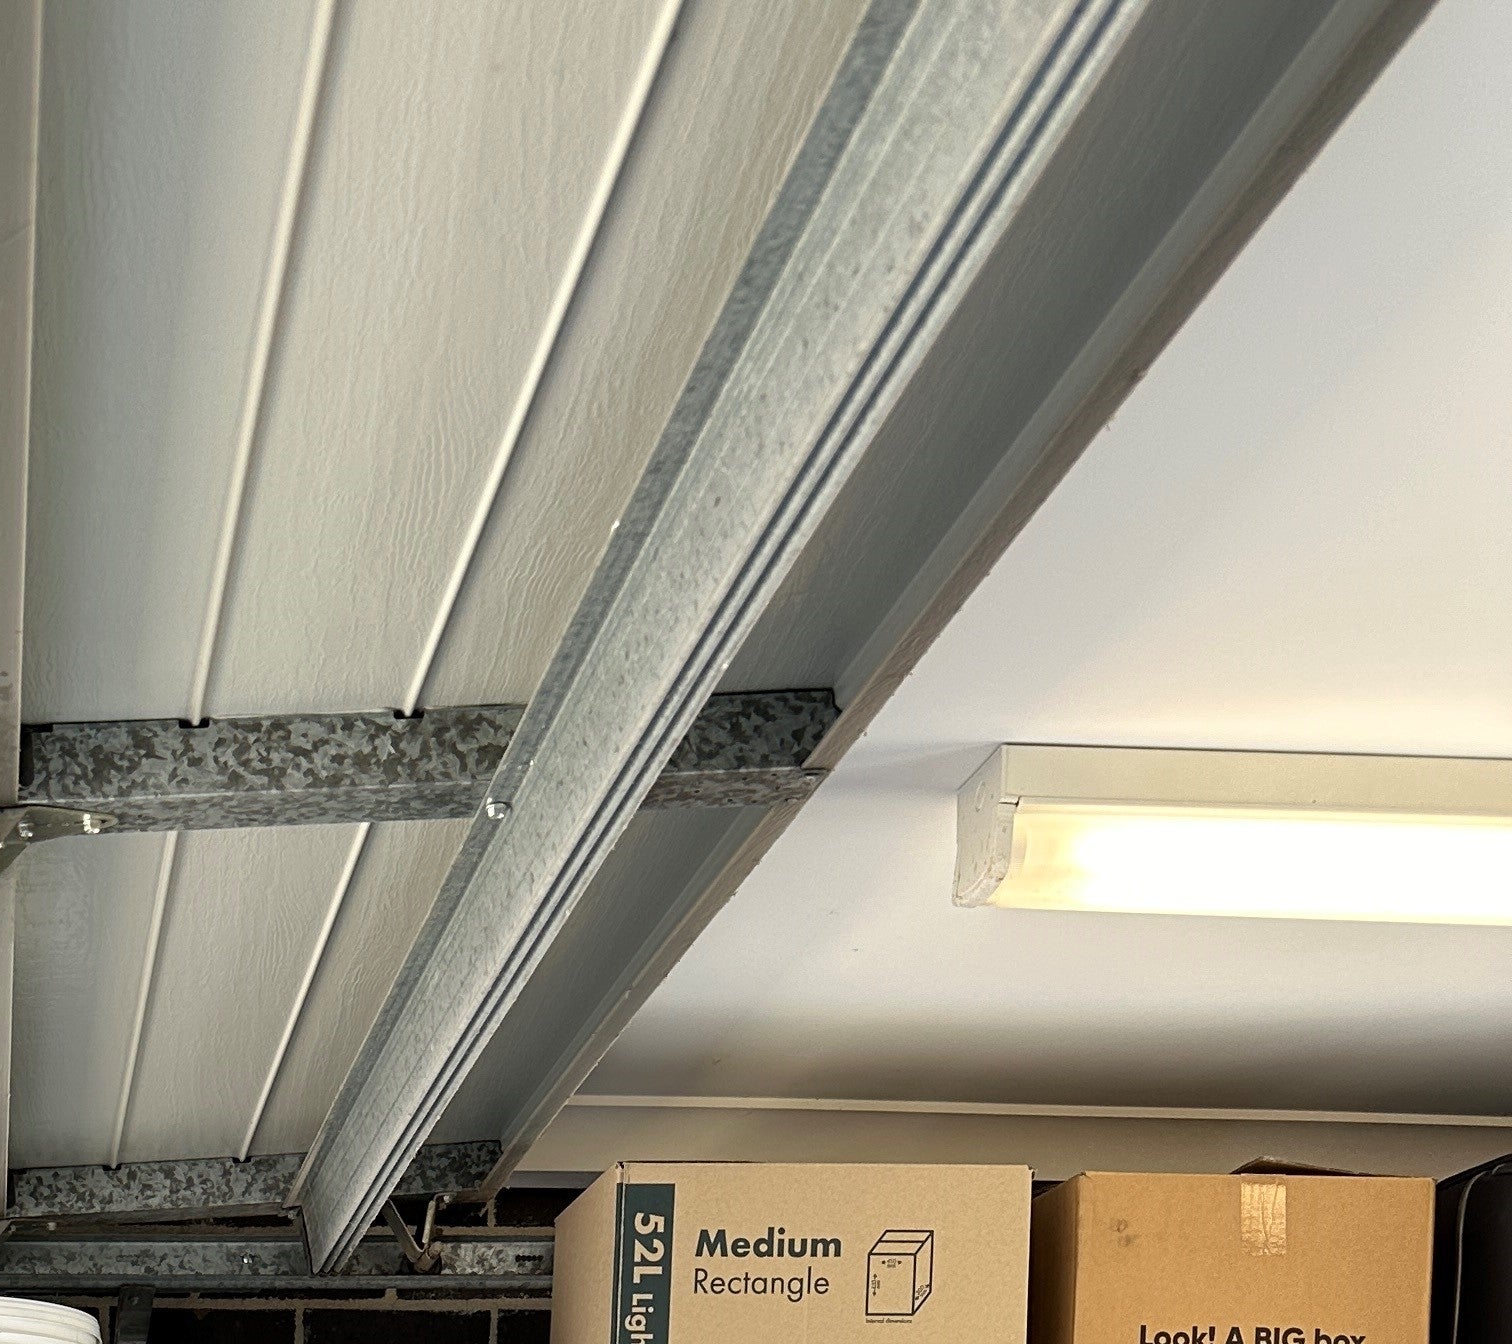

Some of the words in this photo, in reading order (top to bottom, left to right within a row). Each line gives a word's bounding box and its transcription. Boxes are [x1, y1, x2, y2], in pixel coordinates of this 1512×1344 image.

[633, 1211, 666, 1285] 52L
[694, 1226, 843, 1259] Medium
[692, 1265, 830, 1303] Rectangle
